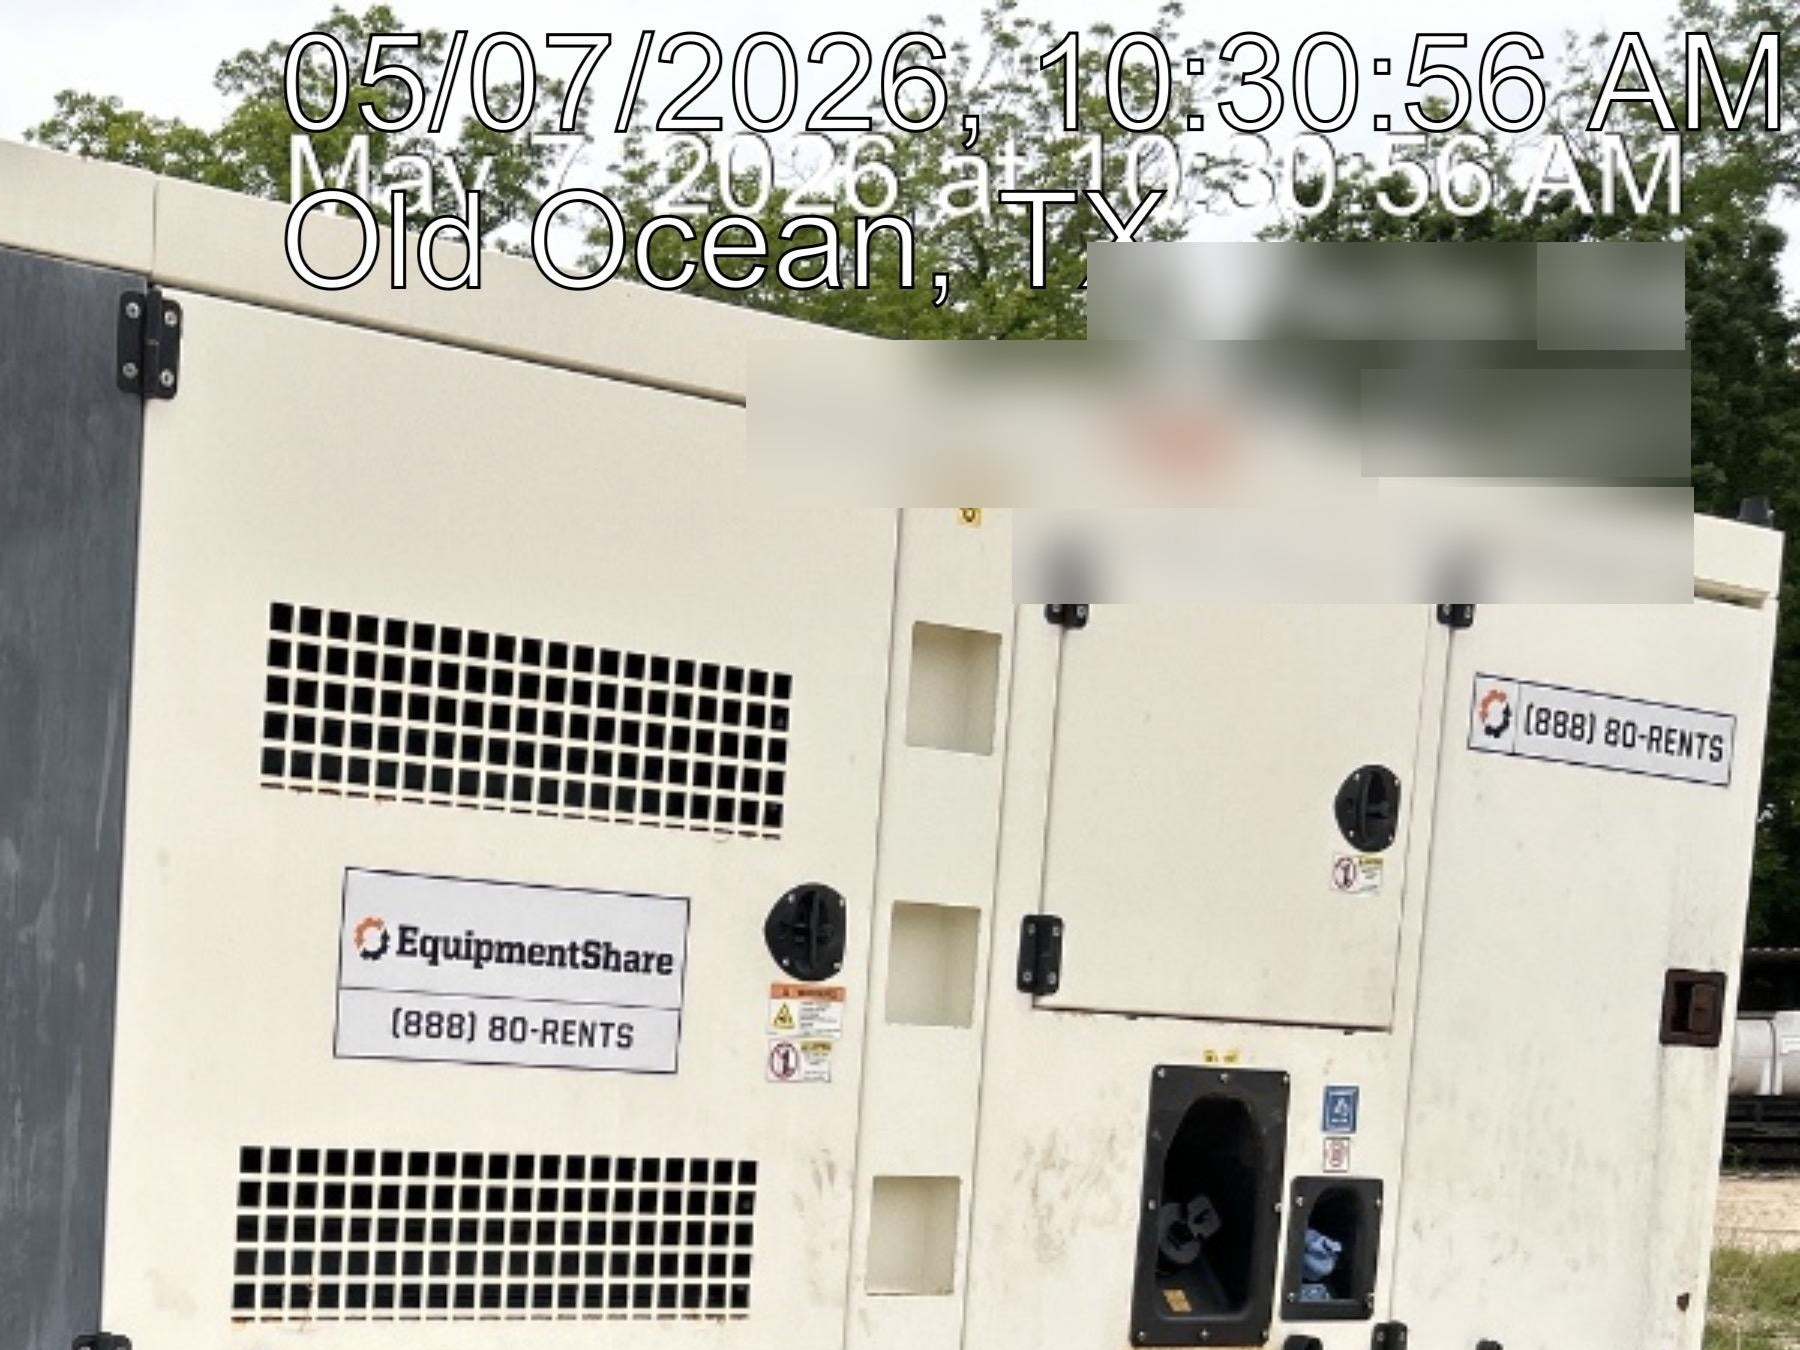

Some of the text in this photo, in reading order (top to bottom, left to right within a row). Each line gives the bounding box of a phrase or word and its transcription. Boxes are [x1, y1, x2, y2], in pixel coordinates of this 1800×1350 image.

[1524, 702, 1724, 763] (888) 80-RENTS
[395, 923, 674, 976] EquipmentShare
[391, 1007, 635, 1050] (888) 80-RENTS
